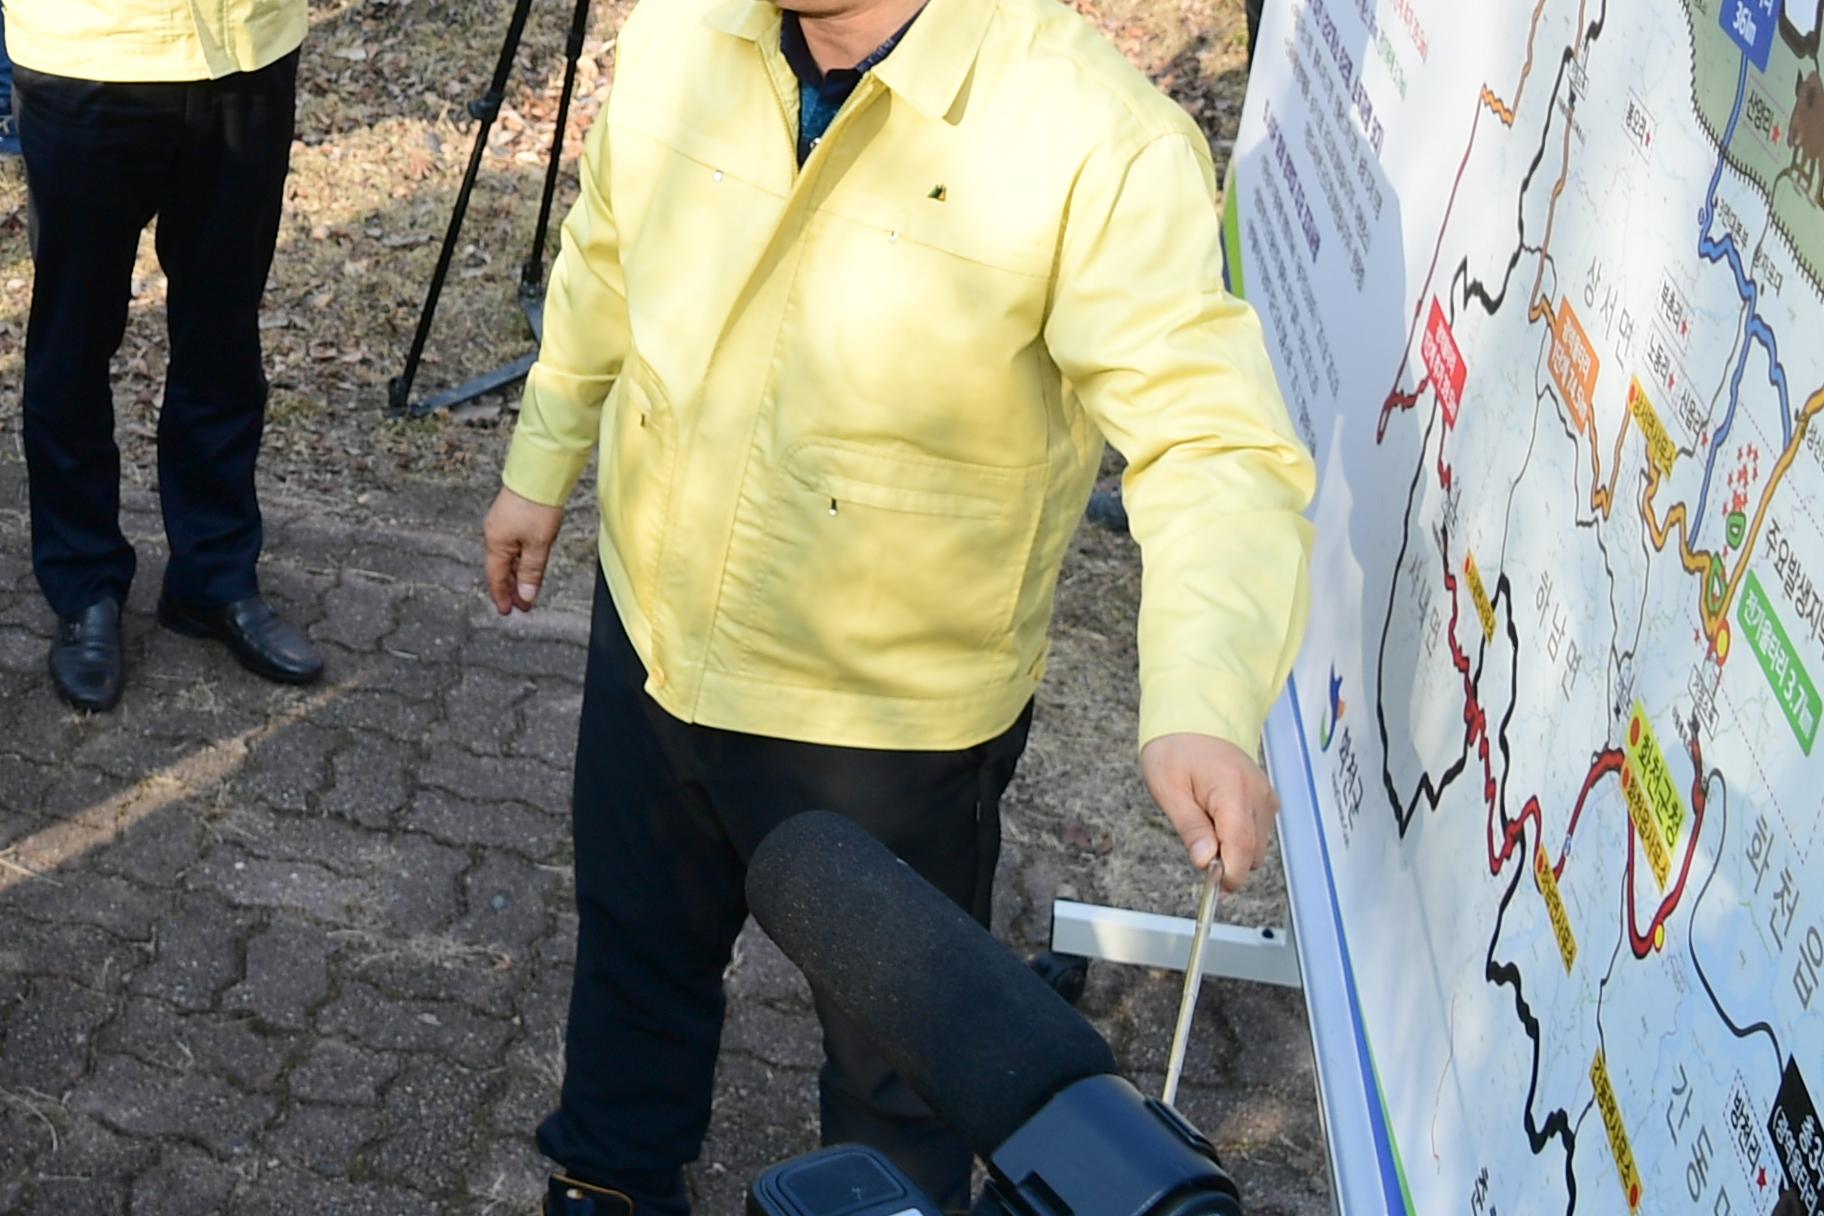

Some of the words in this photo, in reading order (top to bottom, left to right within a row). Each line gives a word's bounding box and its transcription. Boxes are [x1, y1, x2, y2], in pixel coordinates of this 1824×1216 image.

[1746, 90, 1774, 141] 산양리
[1584, 255, 1635, 375] 상서면
[1647, 334, 1672, 386] 노동리
[1536, 571, 1581, 701] 하남면
[1339, 726, 1364, 831] 화천군
[1638, 735, 1683, 848] 화천군청
[1746, 814, 1824, 1011] 화천읍
